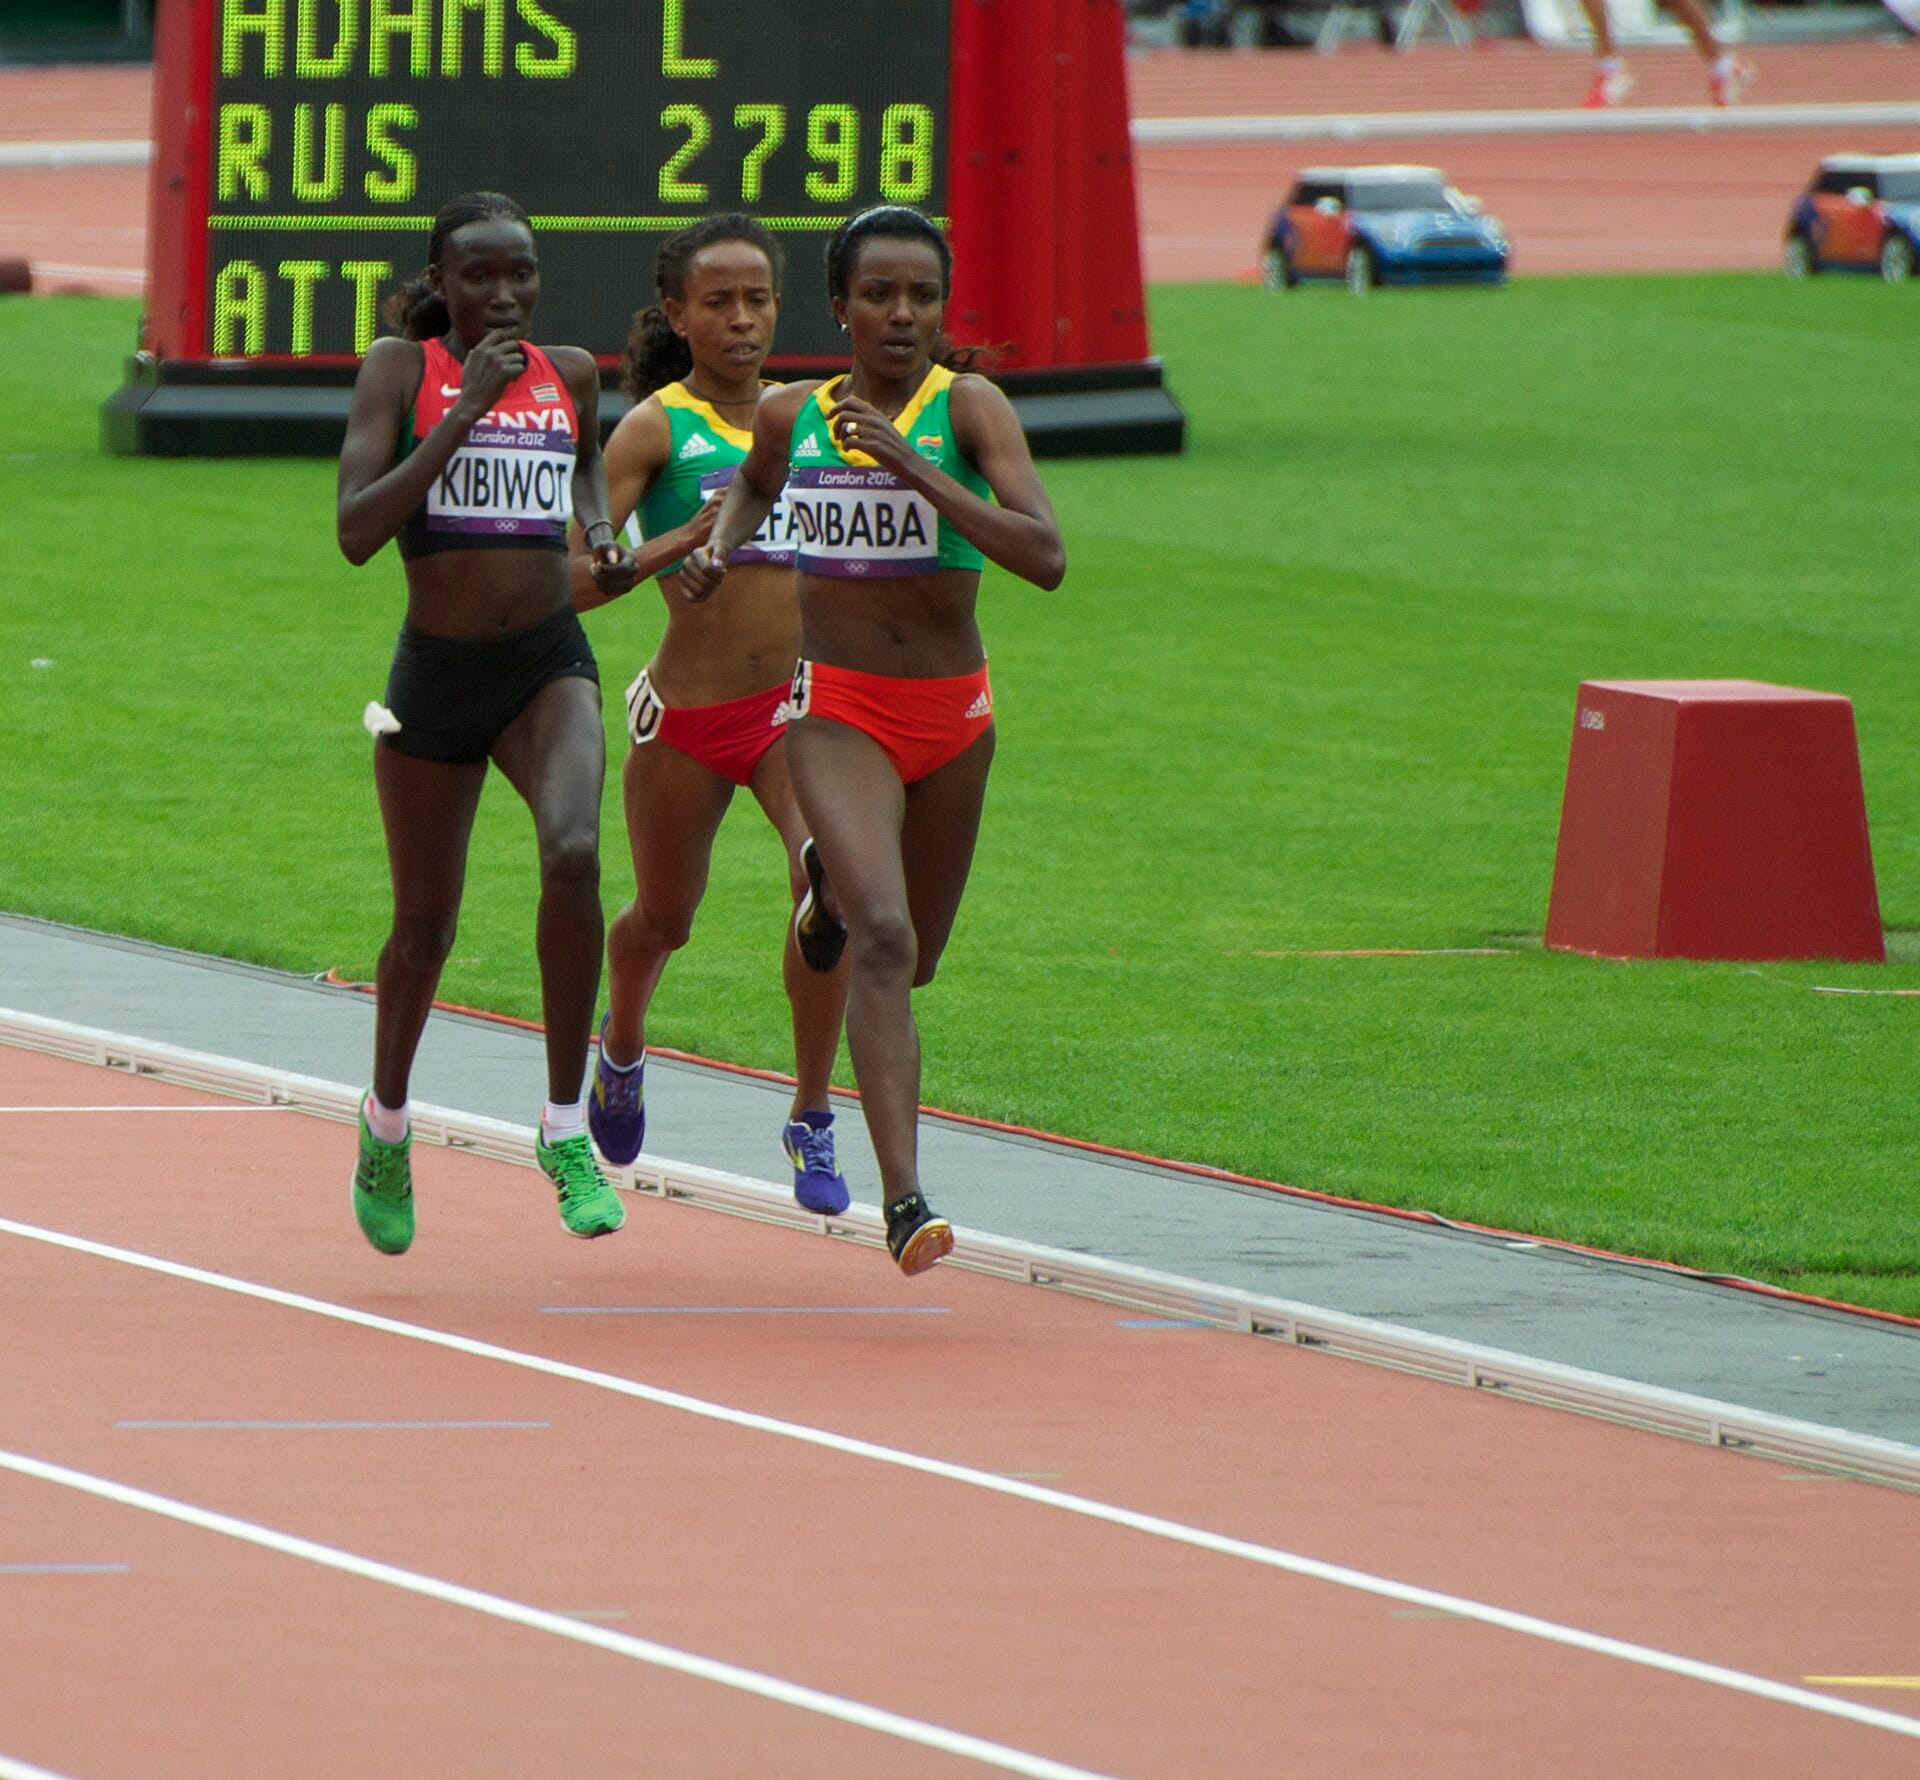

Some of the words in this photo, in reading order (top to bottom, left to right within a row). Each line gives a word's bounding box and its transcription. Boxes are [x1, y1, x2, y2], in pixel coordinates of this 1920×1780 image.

[221, 0, 577, 78] ADAMS
[662, 0, 720, 78] L
[218, 103, 419, 201] RUS
[658, 104, 934, 201] 2798
[213, 260, 393, 358] ATT
[443, 408, 572, 434] NYA
[469, 428, 516, 445] London
[517, 431, 547, 447] 2012
[440, 457, 567, 512] KIBIWOT
[818, 470, 865, 486] London
[795, 501, 928, 547] DIBABA
[629, 675, 659, 737] 10
